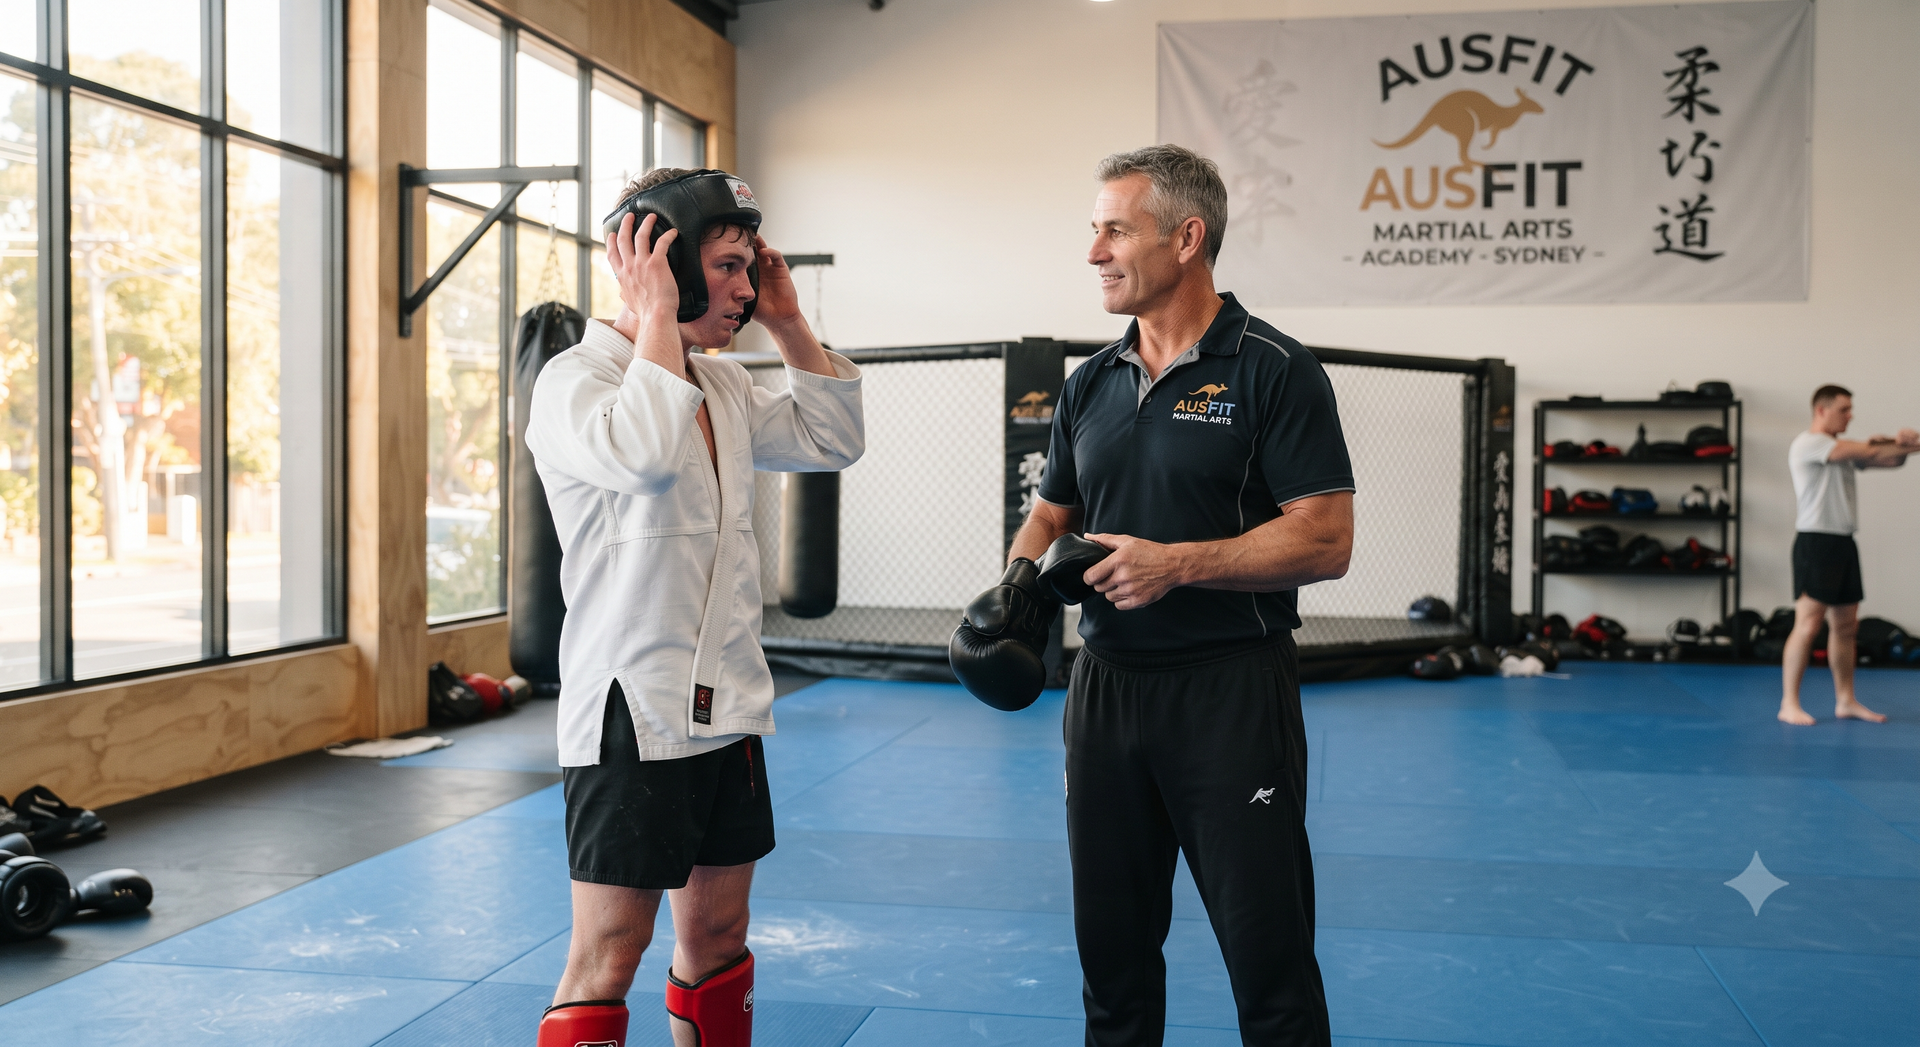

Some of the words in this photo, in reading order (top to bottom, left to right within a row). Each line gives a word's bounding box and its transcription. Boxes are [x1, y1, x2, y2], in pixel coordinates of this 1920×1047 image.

[1379, 33, 1595, 103] AUSFIT
[1359, 160, 1583, 211] AUSFIT
[1373, 221, 1493, 242] MARTIAL
[1502, 219, 1573, 240] ARTS
[1360, 248, 1473, 267] ACADEMY
[1494, 246, 1585, 265] SYDNEY
[1172, 412, 1208, 422] MARTIAL
[1209, 416, 1232, 425] ARTS
[1173, 400, 1236, 416] AUSFIT
